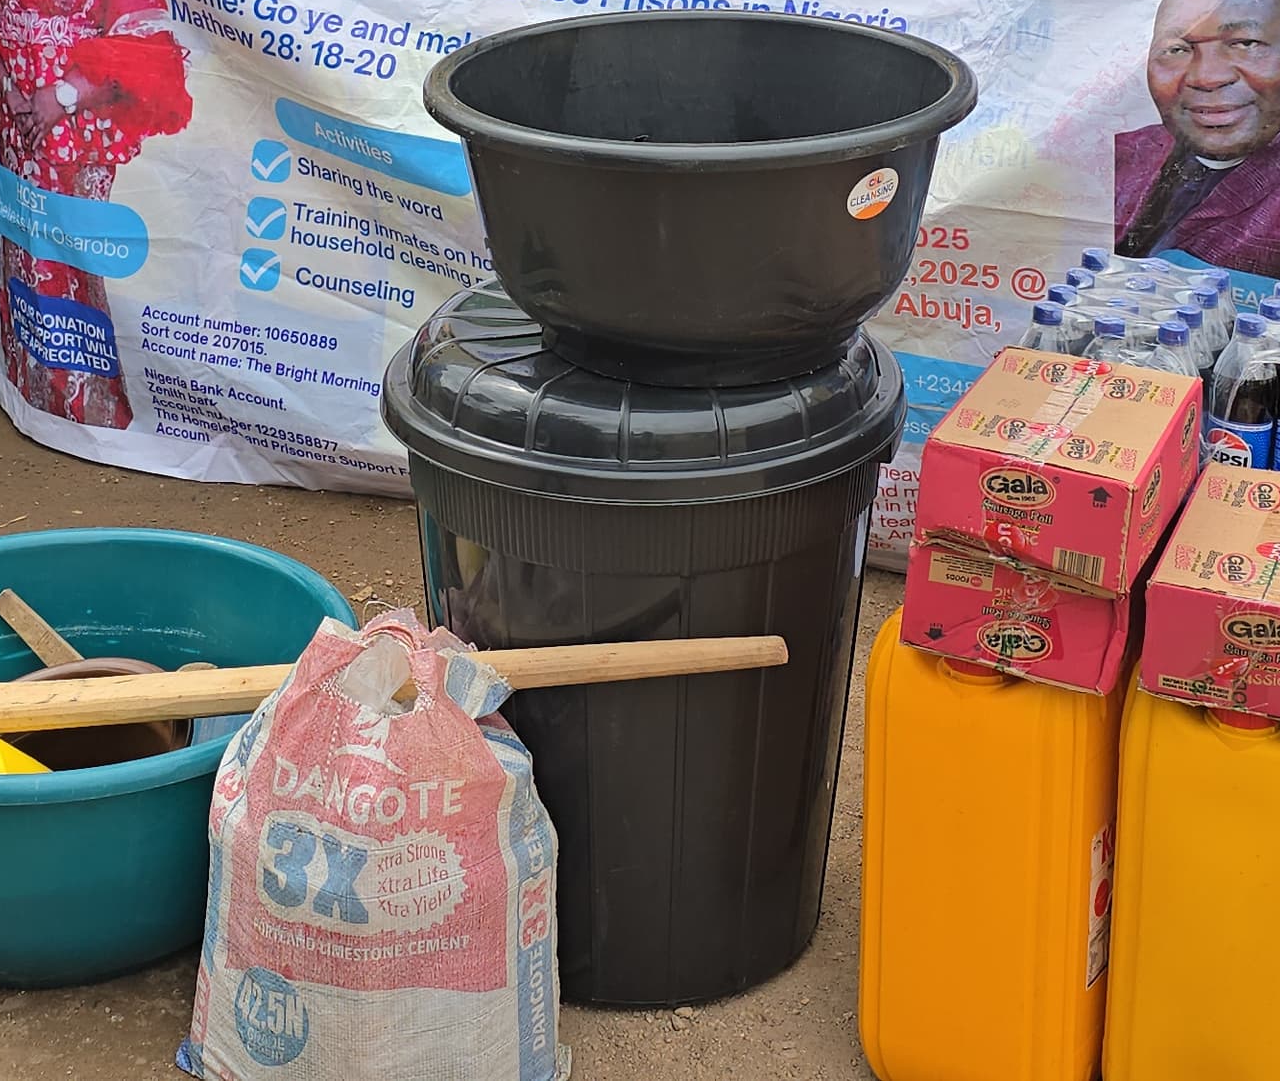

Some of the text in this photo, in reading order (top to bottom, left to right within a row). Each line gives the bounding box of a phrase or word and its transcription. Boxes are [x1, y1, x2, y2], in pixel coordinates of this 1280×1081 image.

[304, 8, 344, 35] ye
[350, 19, 411, 47] and
[261, 30, 302, 63] 28:
[311, 40, 398, 81] 18-20
[314, 121, 393, 165] Activities
[297, 157, 443, 221] Sharing the word
[850, 182, 894, 207] CLEANSING
[51, 226, 129, 259] Osarobo
[294, 202, 370, 237] Training
[374, 219, 440, 256] inmates
[444, 248, 466, 265] on
[291, 226, 471, 289] household cleaning
[296, 267, 415, 309] Counseling
[1011, 267, 1046, 301] @
[36, 310, 106, 342] DONATION
[142, 305, 338, 351] Account number: 10650889
[894, 293, 1001, 333] Abuja,
[29, 336, 111, 371] APPRECIATED
[85, 338, 118, 360] WILL
[141, 322, 268, 356] Sort code 207015.
[142, 338, 381, 397] Account name: The Bright Morning
[144, 367, 288, 412] Nigeria Bank Account.
[147, 381, 187, 401] Zenith
[154, 407, 179, 422] The
[272, 440, 336, 464] Prisoners
[339, 455, 396, 475] Support
[156, 422, 211, 443] Account
[205, 409, 252, 431] nuber
[255, 423, 338, 452] 1229358877
[1210, 450, 1249, 467] EPSI
[986, 475, 1049, 495] Gala
[273, 757, 466, 823] DANGOTE
[262, 820, 368, 924] 3X
[377, 843, 447, 873] xtra Strong
[377, 866, 449, 894] xtra Life
[378, 884, 452, 918] xtra Yield
[320, 942, 404, 962] LIMESTONE
[408, 934, 470, 956] CEMENT
[531, 945, 547, 1052] DANGOTE
